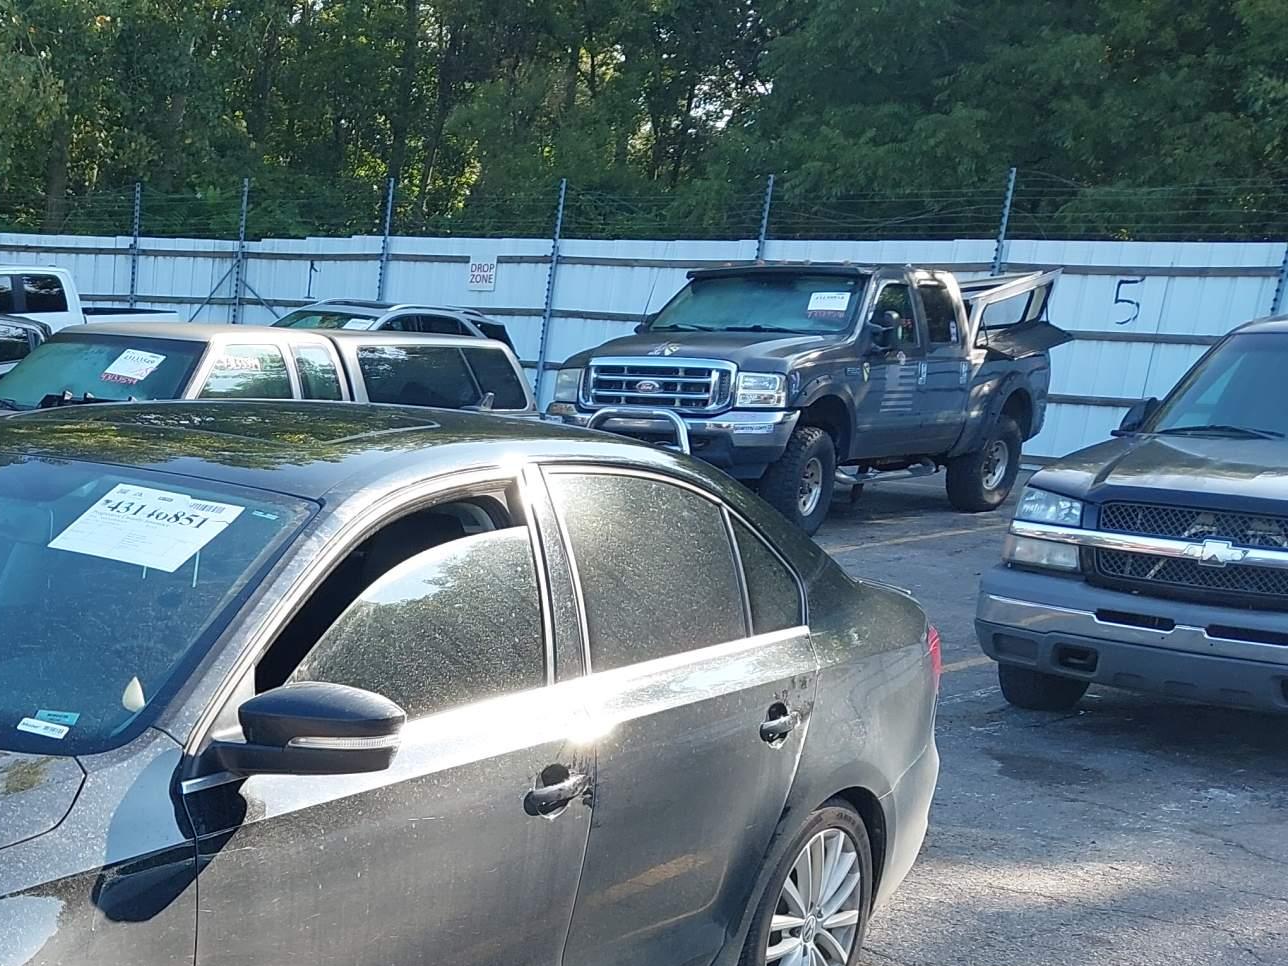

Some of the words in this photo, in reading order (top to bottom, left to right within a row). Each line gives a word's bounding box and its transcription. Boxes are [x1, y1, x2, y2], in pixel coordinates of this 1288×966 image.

[470, 263, 495, 273] DROP
[469, 274, 494, 284] ZONE
[1114, 276, 1146, 325] 5
